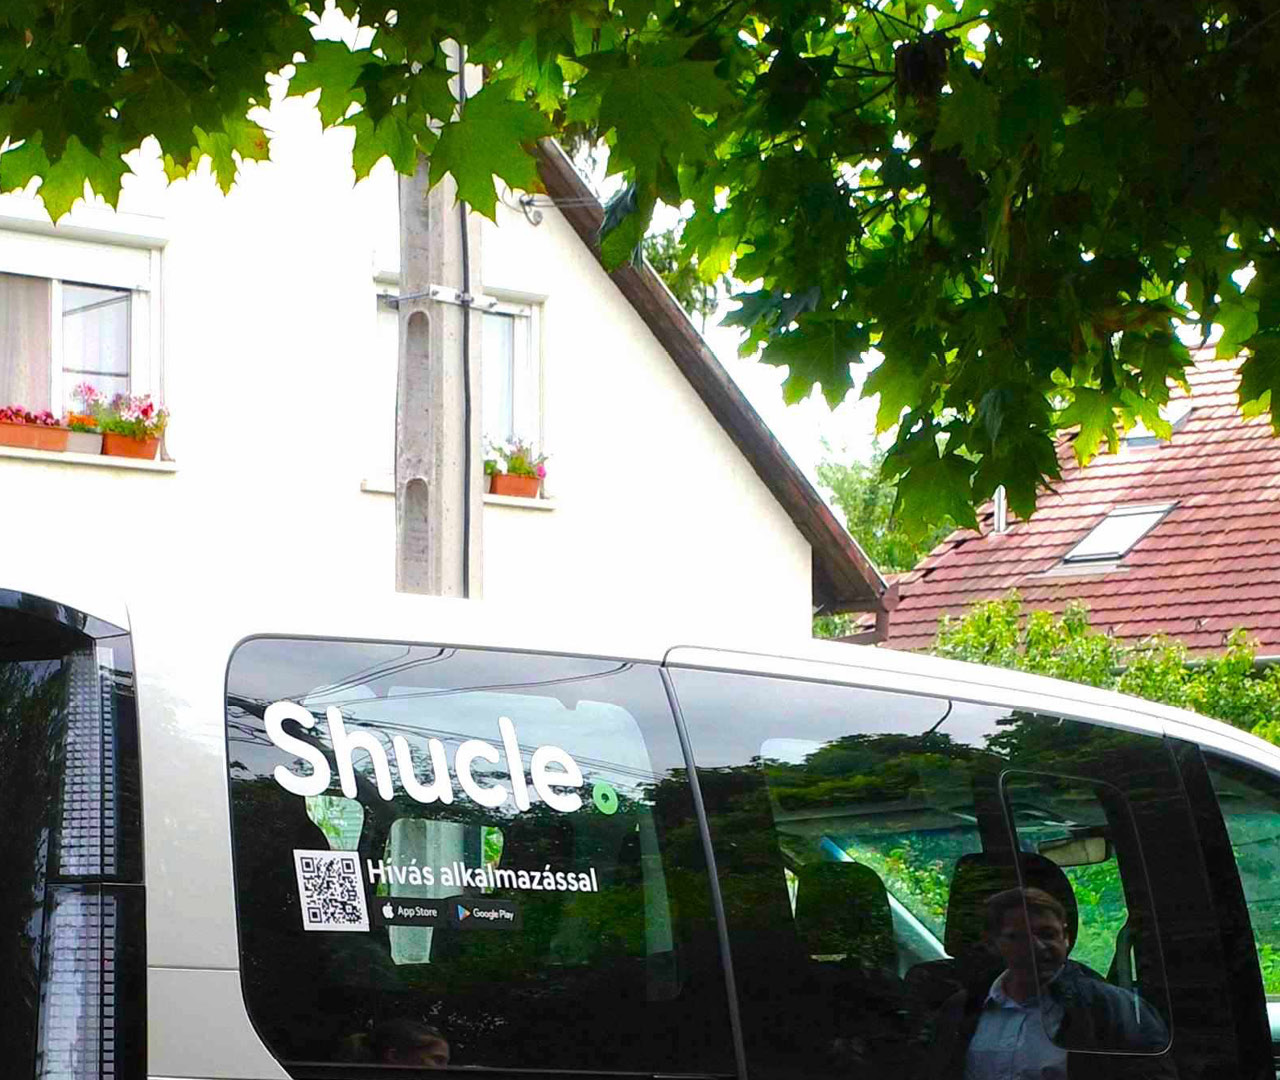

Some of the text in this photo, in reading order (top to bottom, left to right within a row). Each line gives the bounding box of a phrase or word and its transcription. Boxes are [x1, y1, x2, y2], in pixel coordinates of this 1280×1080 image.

[264, 700, 585, 813] Shucle
[366, 857, 599, 893] Hívás alkalmazással
[397, 905, 438, 917] App Store
[472, 908, 514, 921] Google Play
